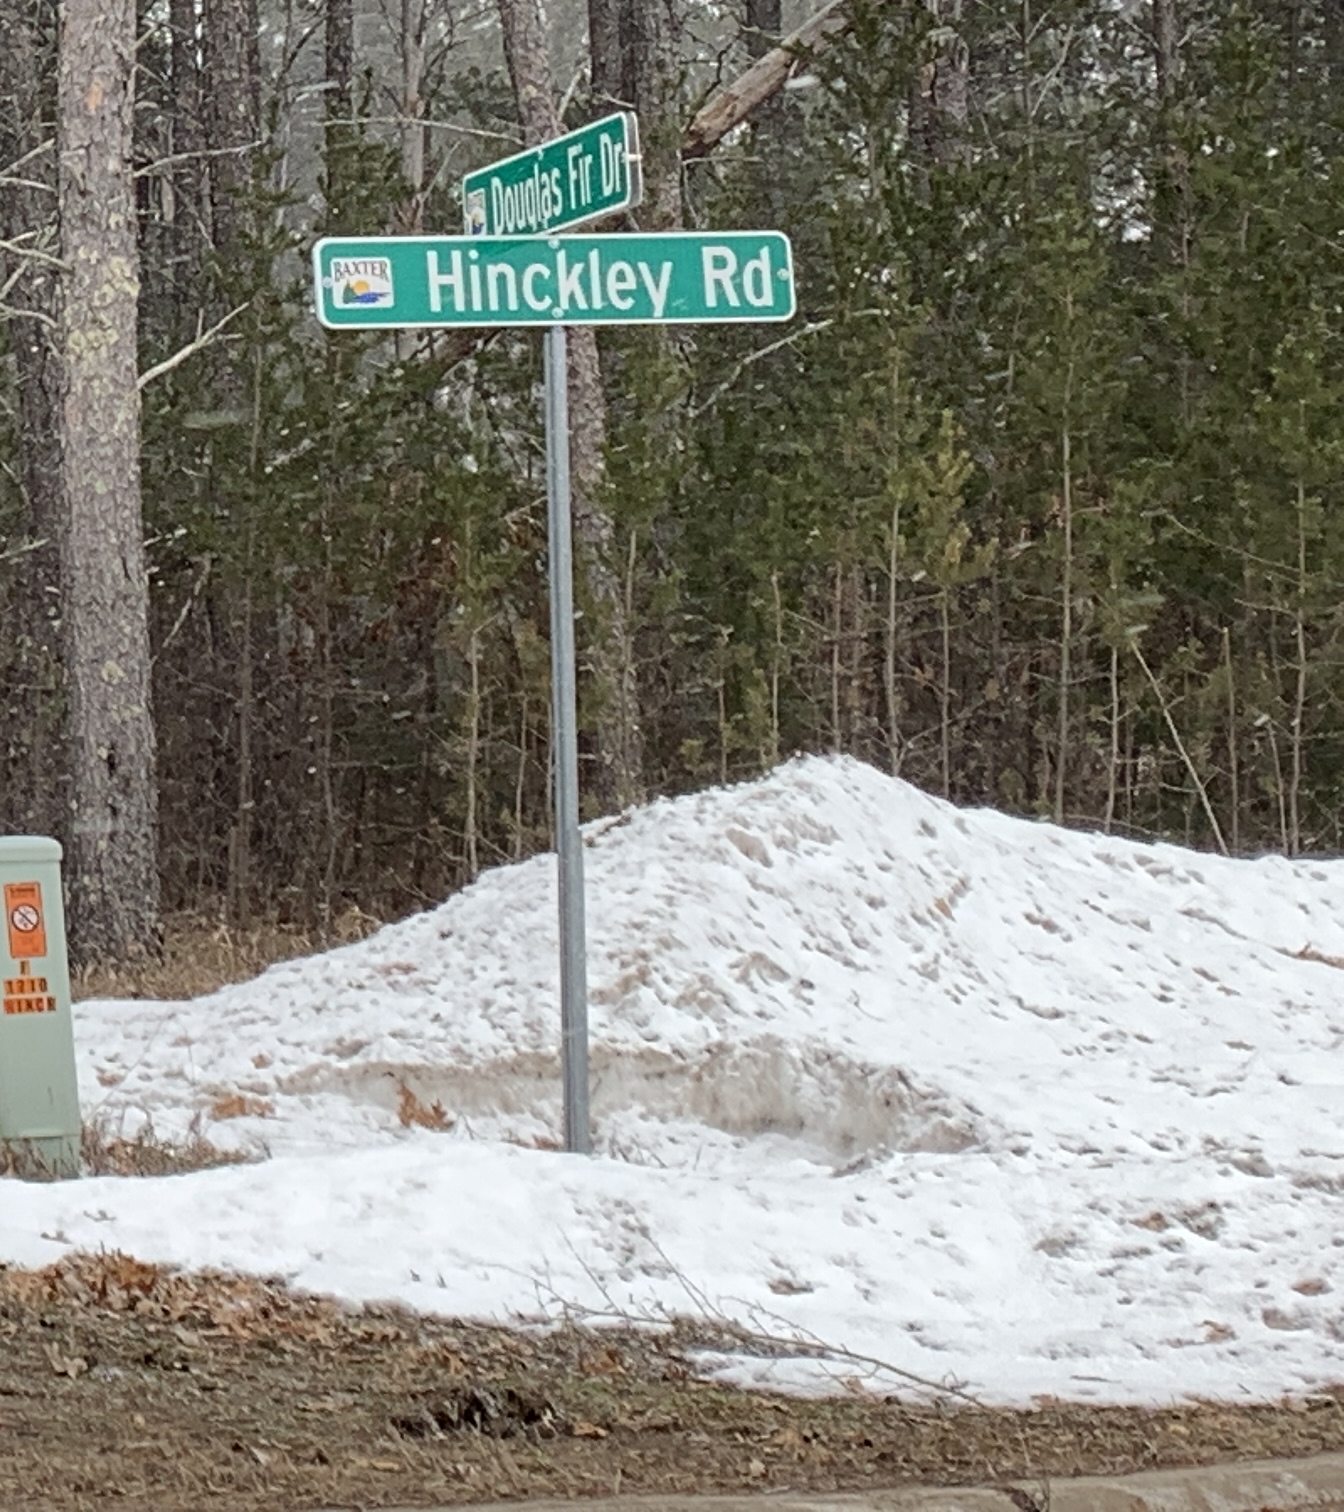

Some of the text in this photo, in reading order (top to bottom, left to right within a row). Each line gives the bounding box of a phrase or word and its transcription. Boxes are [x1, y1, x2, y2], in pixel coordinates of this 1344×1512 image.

[491, 132, 623, 236] Douglas Fir Dr
[332, 261, 390, 283] BAXTER
[426, 245, 774, 317] Hinckley Rd
